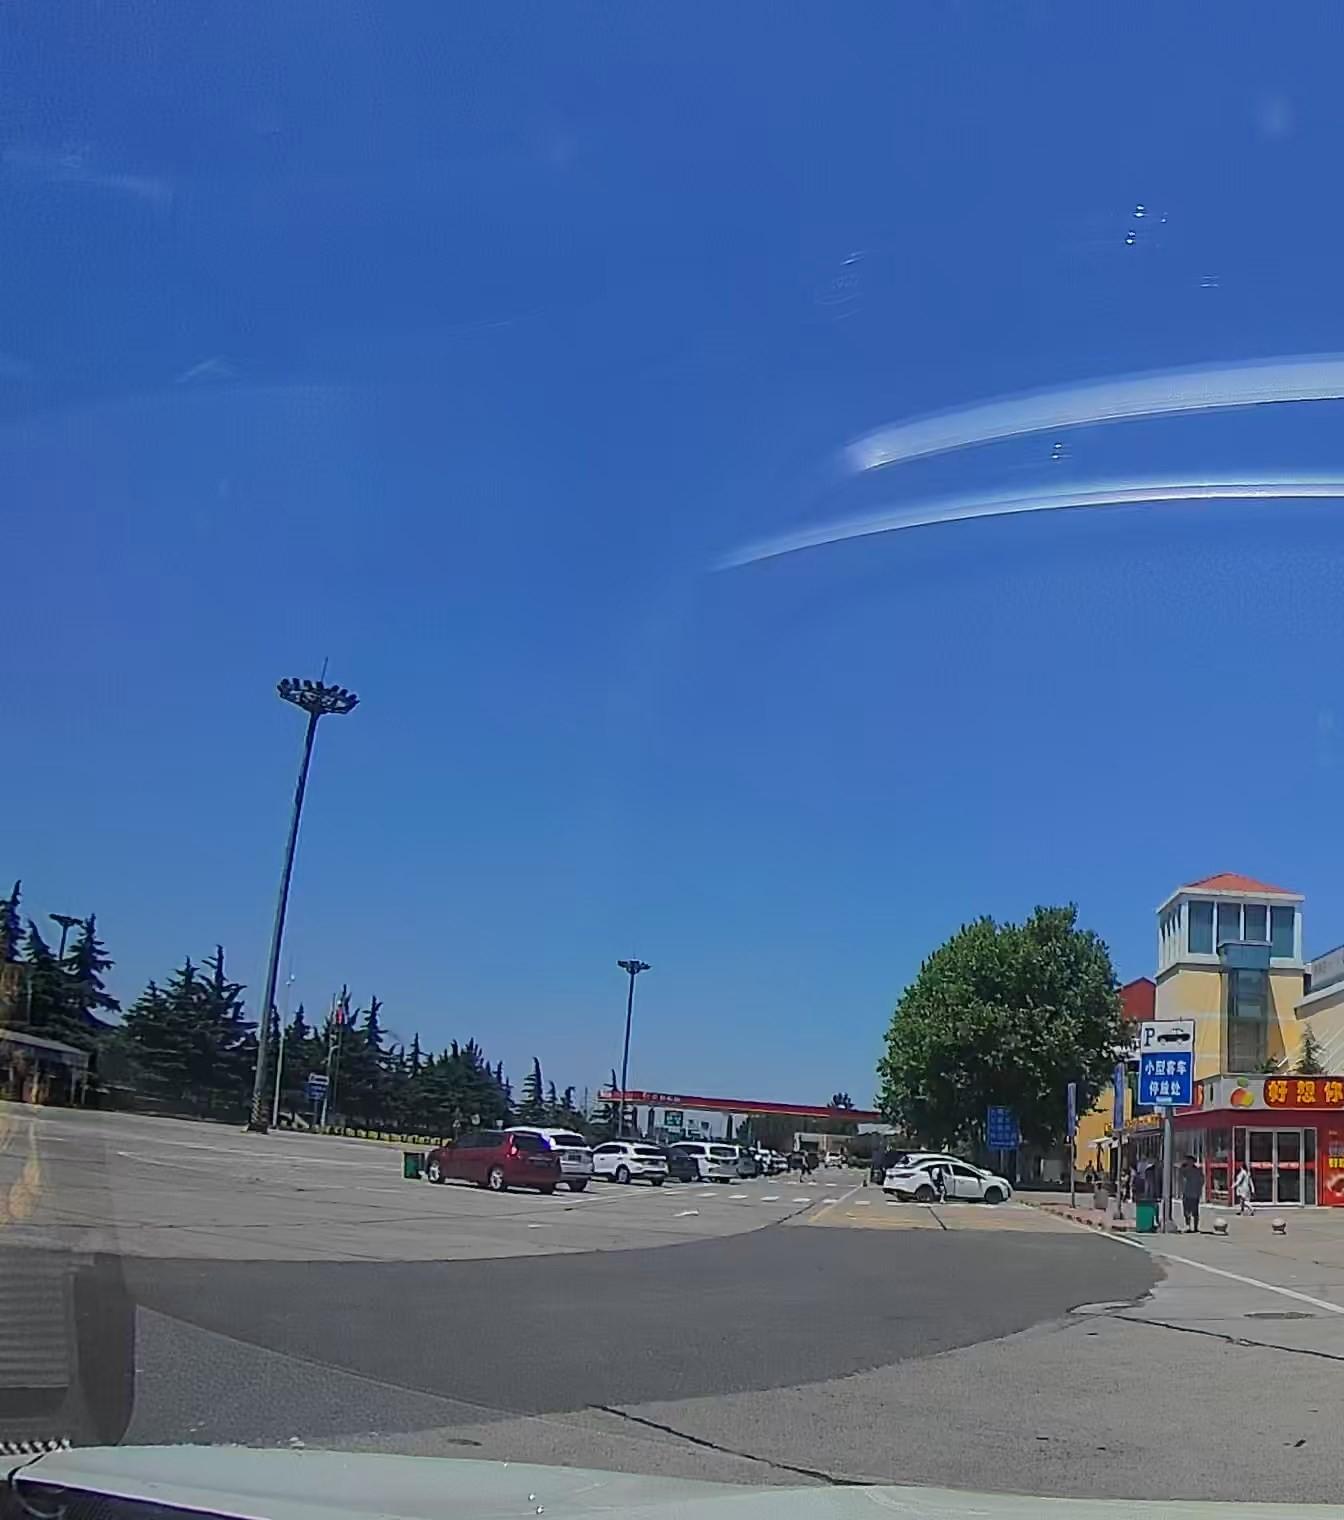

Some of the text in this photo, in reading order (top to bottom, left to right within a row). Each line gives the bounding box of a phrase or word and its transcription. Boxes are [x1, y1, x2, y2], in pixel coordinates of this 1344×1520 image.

[1144, 1028, 1155, 1047] P
[1145, 1059, 1187, 1076] 小型客车
[1268, 1080, 1344, 1104] 好想你
